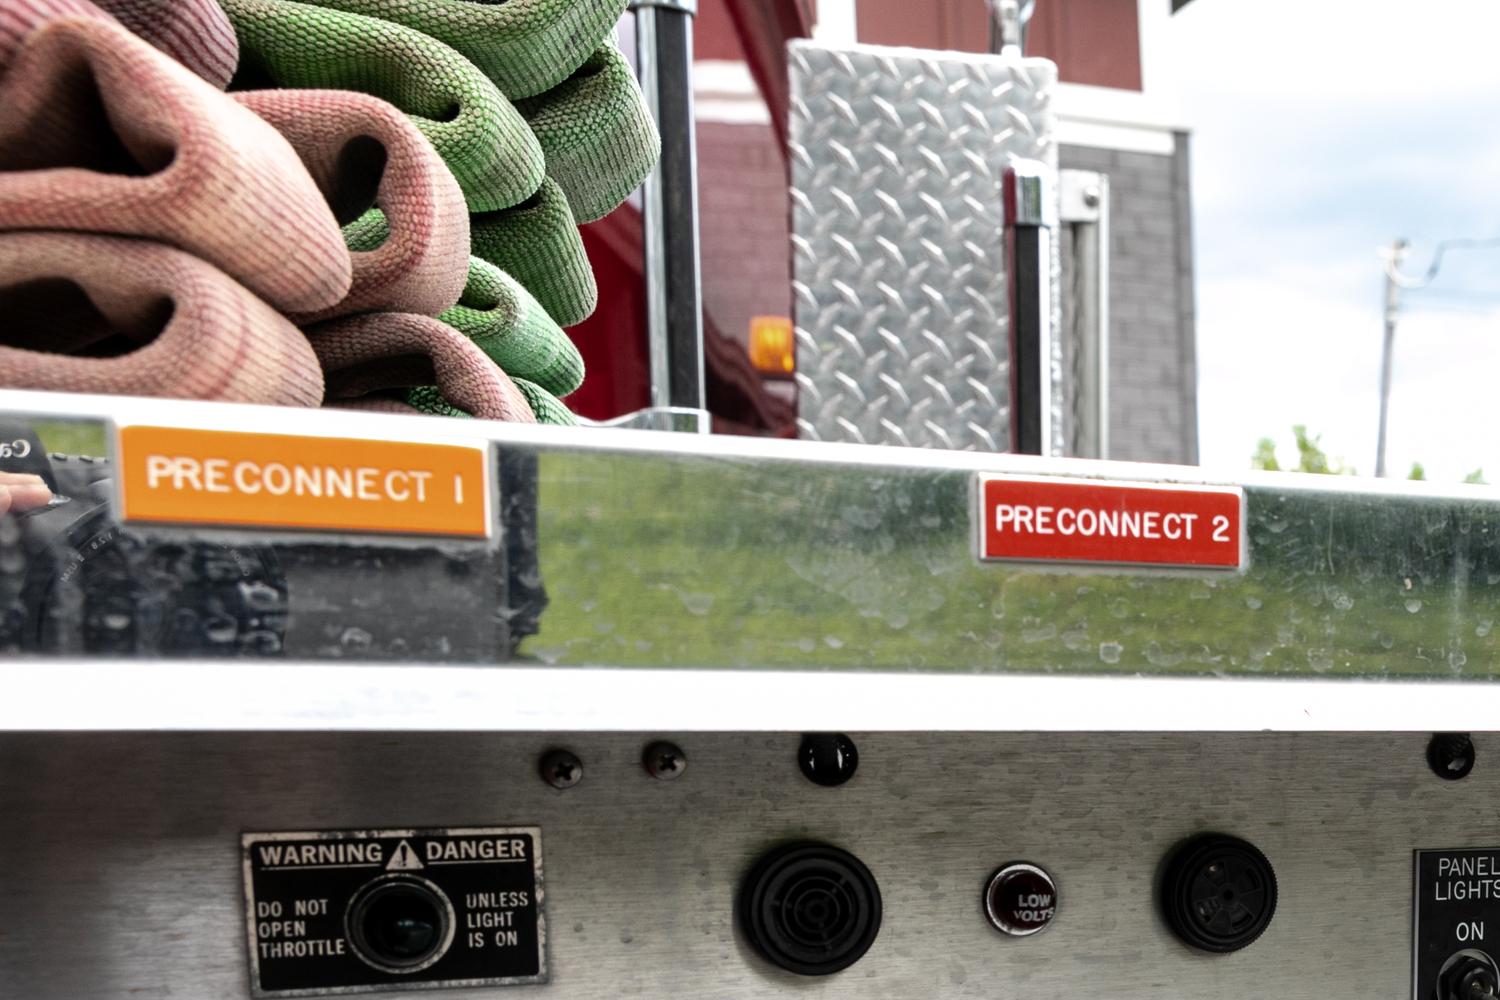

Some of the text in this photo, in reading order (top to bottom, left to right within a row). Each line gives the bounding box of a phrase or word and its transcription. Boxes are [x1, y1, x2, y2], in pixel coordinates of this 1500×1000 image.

[147, 454, 433, 502] PRECONNECT
[996, 504, 1231, 543] PRECONNECT 2
[259, 842, 383, 866] WARNING
[426, 839, 526, 860] DANGER
[258, 899, 328, 918] DO NOT
[466, 891, 529, 909] UNLESS
[1018, 894, 1051, 908] LOW
[467, 911, 514, 929] LIGHT
[1012, 906, 1055, 922] VOLTS
[258, 920, 306, 939] OPEN
[468, 930, 518, 948] IS ON
[1455, 922, 1485, 941] ON
[259, 938, 345, 959] THROTTLE
